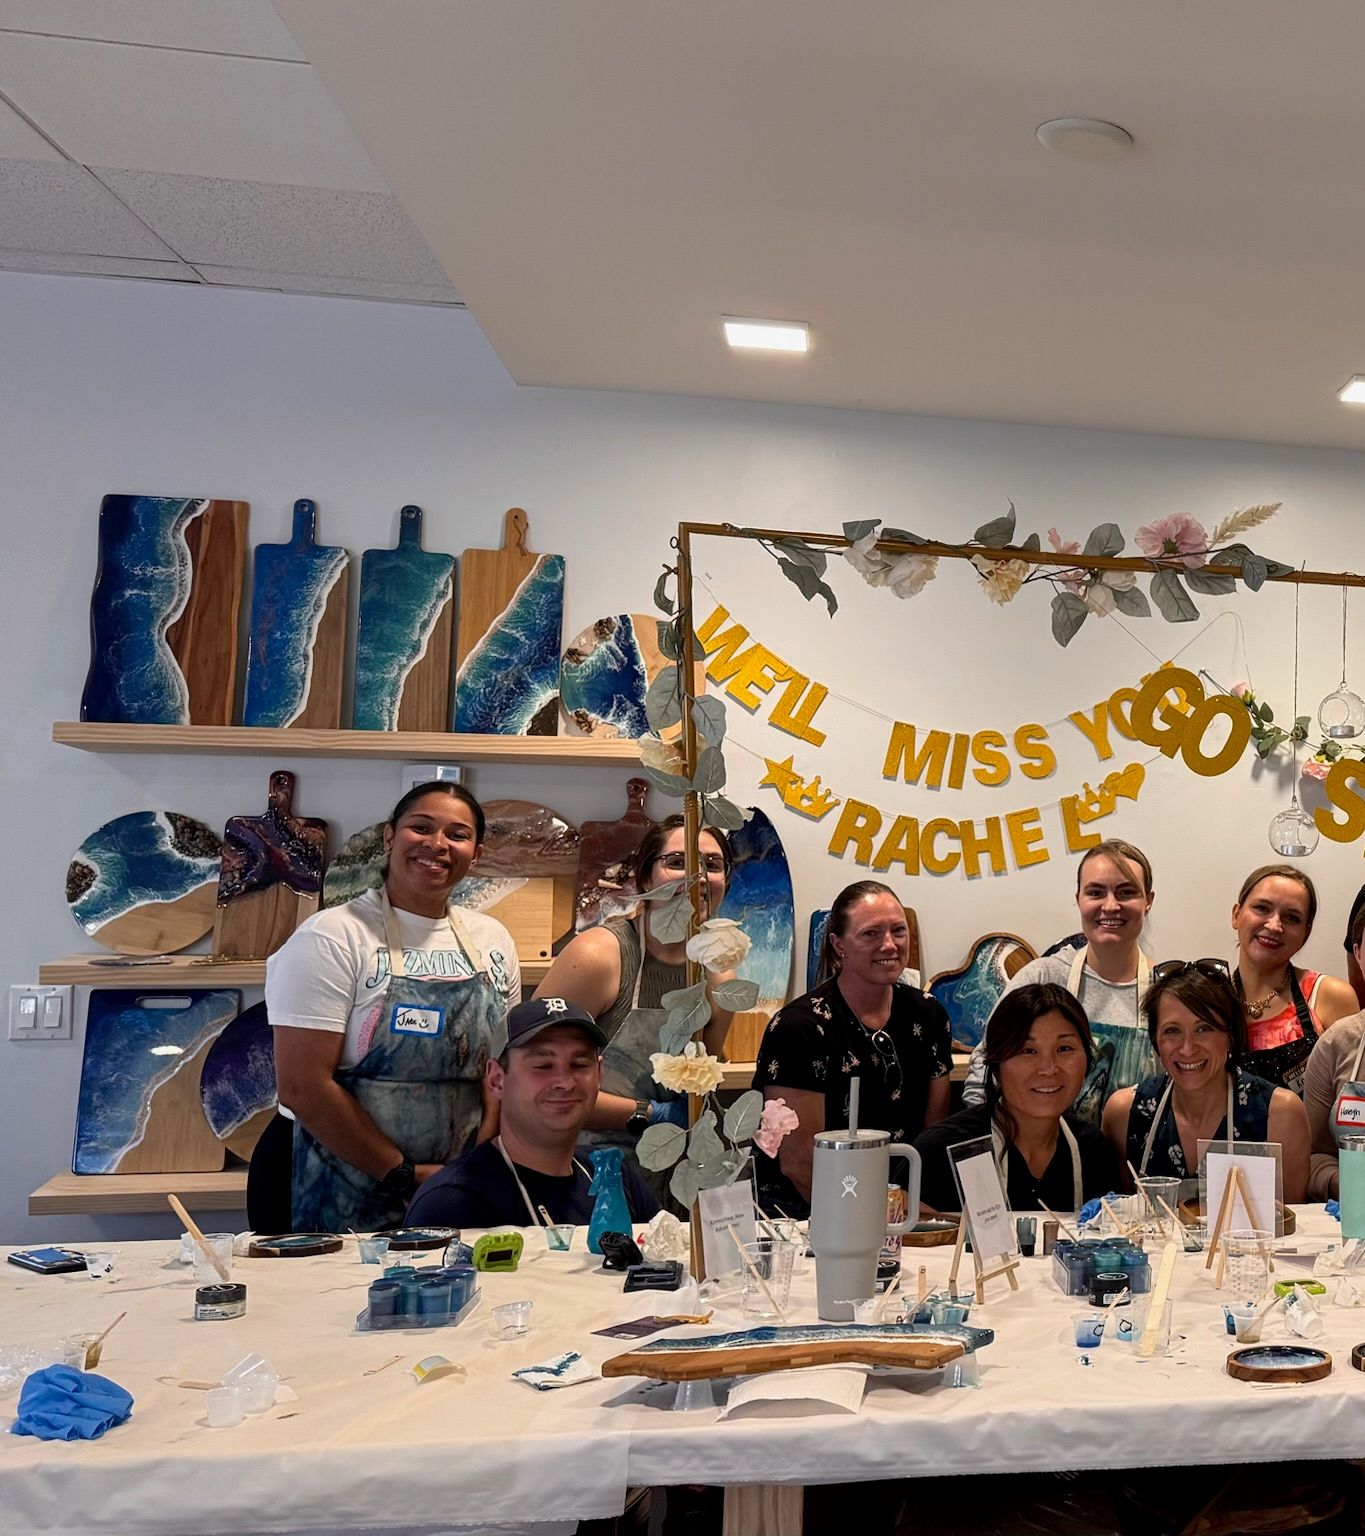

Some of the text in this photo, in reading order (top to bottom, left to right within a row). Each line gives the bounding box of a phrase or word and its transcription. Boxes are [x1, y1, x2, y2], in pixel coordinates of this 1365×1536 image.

[697, 604, 829, 748] WE'LL
[882, 721, 1057, 790] MISS
[1130, 667, 1251, 777] GO
